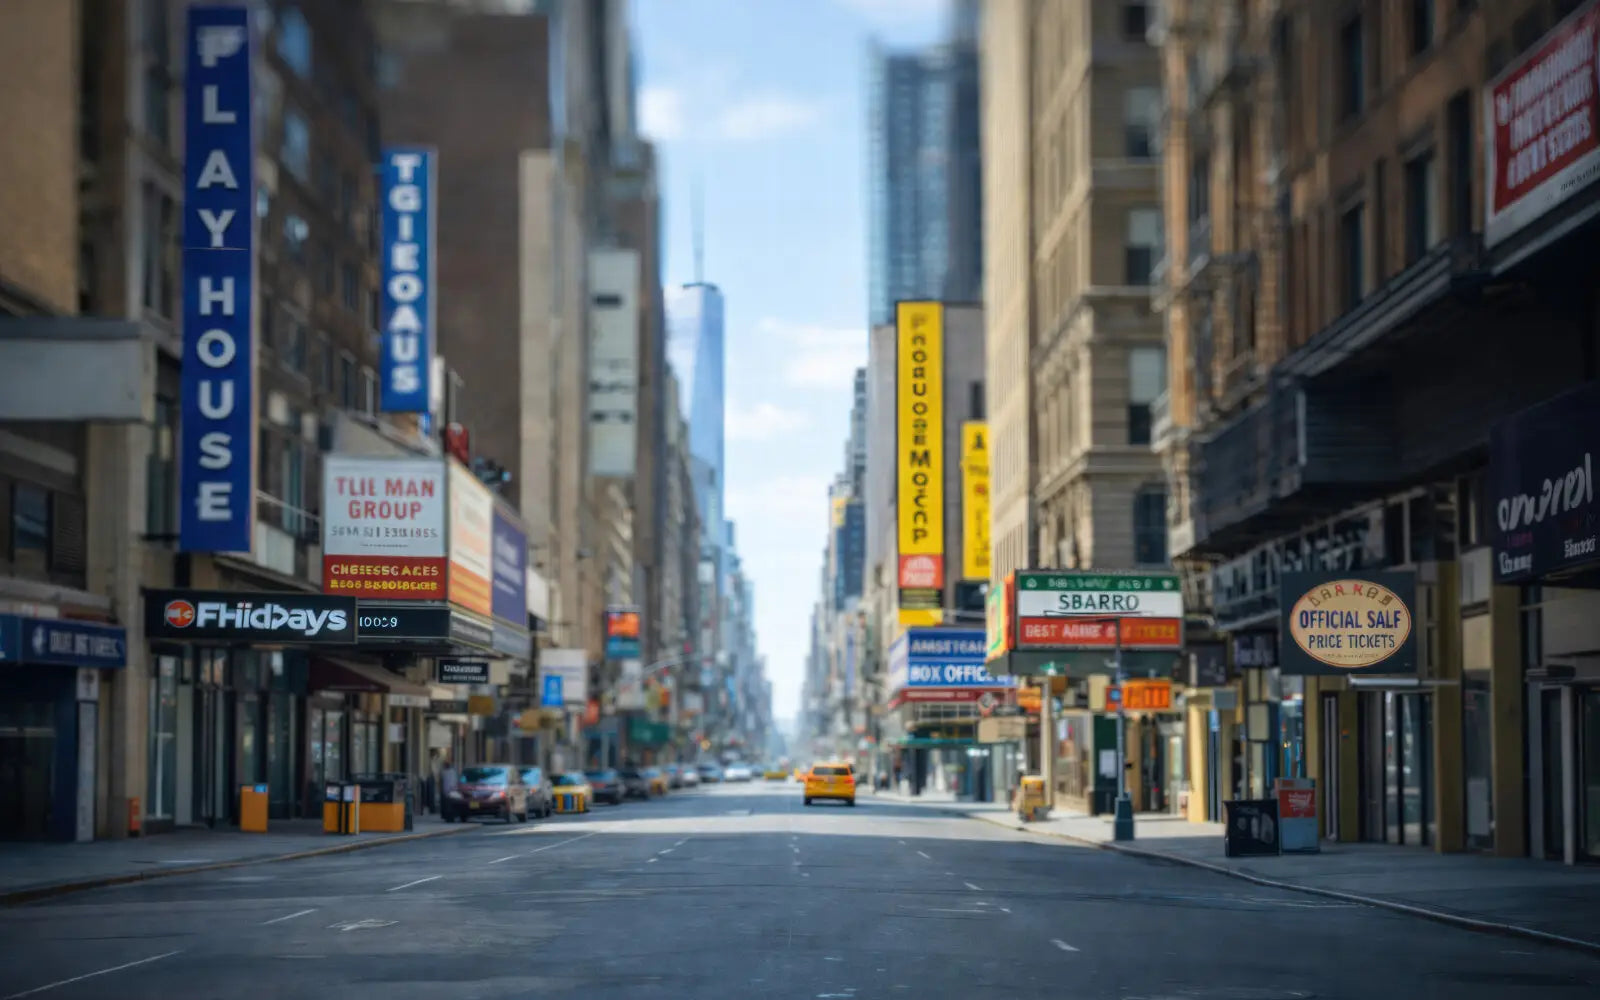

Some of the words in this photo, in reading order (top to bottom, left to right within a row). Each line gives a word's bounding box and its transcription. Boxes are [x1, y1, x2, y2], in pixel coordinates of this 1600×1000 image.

[385, 477, 434, 498] MAN
[348, 500, 422, 520] GROUP
[1059, 594, 1139, 611] SBARRO
[1300, 610, 1362, 629] OFFICIAL
[1308, 635, 1342, 648] PRICE
[1347, 635, 1395, 648] TICKETS
[910, 665, 940, 681] BOX
